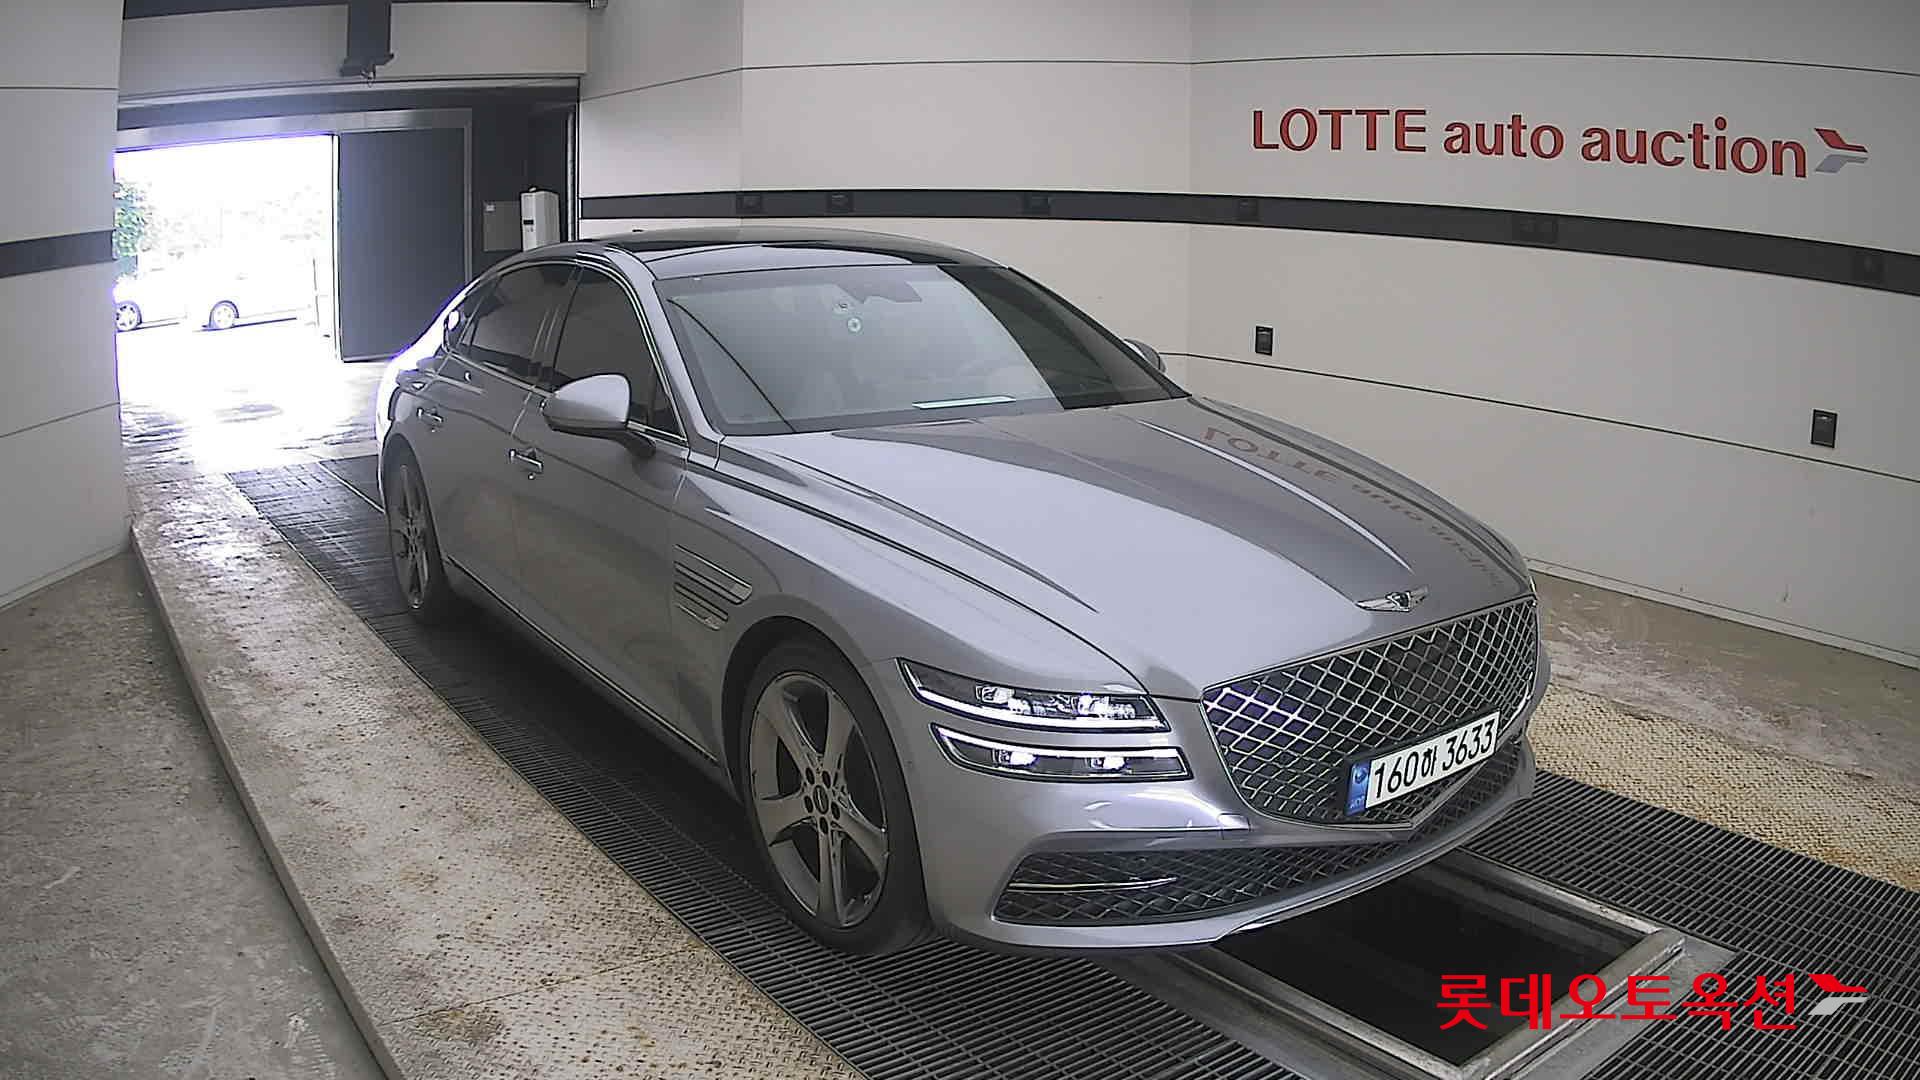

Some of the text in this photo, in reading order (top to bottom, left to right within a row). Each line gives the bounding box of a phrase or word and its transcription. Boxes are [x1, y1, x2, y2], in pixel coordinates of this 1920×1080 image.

[1252, 107, 1808, 179] LOTTE auto auction
[1374, 718, 1496, 799] 160하 3633
